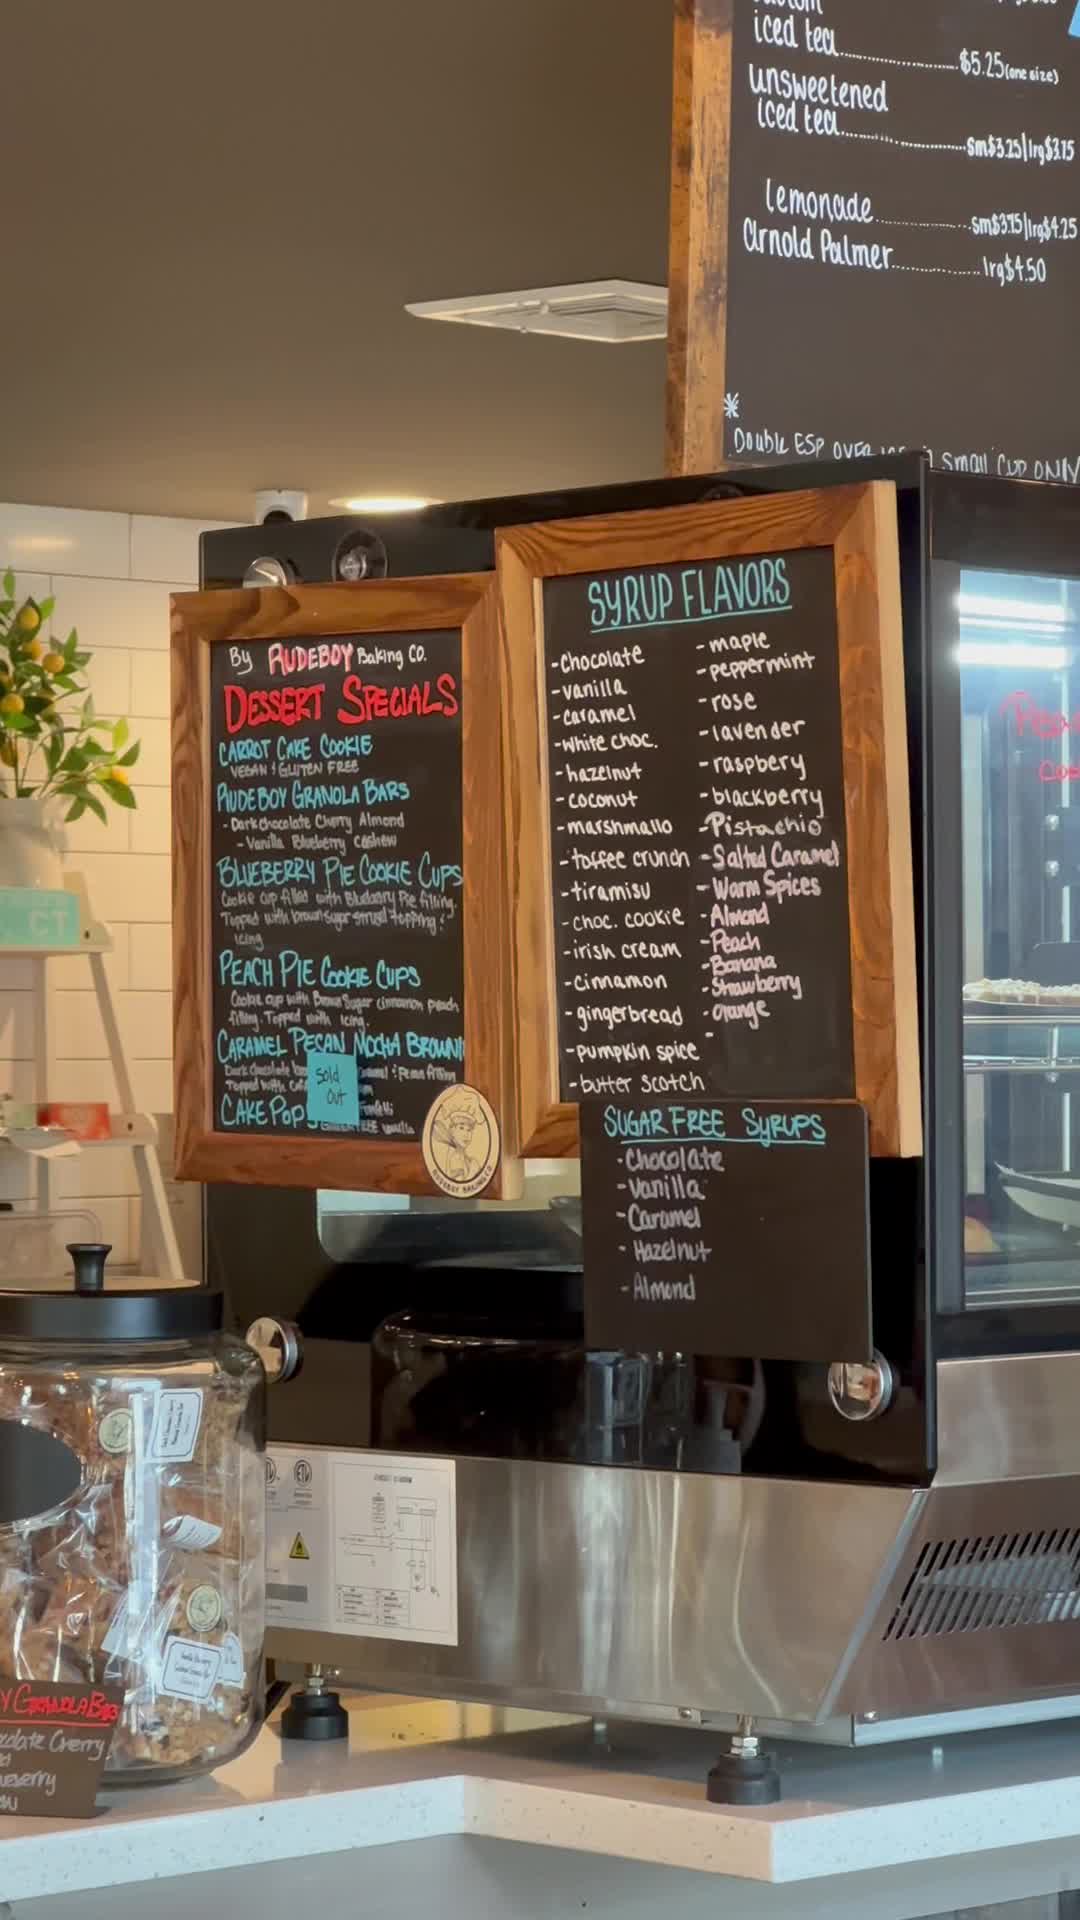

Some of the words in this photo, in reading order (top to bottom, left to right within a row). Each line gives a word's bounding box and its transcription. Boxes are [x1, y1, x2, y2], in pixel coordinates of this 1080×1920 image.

[753, 9, 799, 48] iced
[805, 17, 840, 57] tea
[804, 104, 840, 135] tea
[820, 228, 894, 270] Palmer
[794, 432, 824, 458] ESP
[588, 573, 673, 626] SYRUP
[681, 558, 790, 616] FLAVORS
[709, 631, 770, 653] maple
[229, 646, 253, 675] By
[268, 642, 353, 676] RUDEBOY
[357, 647, 404, 671] Baking
[709, 651, 816, 682] peppermint
[562, 678, 628, 700] vanilla
[711, 691, 757, 713] rose
[223, 683, 326, 733] DESSERT
[336, 673, 459, 724] SPECIALS
[563, 704, 636, 726] caramel
[712, 719, 805, 742] lavender
[218, 738, 272, 766] CARROT
[276, 735, 311, 761] CAKE
[319, 733, 374, 756] COOKIE
[230, 764, 268, 778] VEGAN
[278, 762, 324, 777] GLUTEN
[327, 759, 360, 775] FREE
[566, 762, 643, 783] hazelnut
[216, 781, 287, 813] RUDEBOY
[291, 779, 360, 809] GRANOLA
[361, 778, 410, 806] BARS
[568, 789, 638, 809] coconut
[712, 786, 825, 818] blackberry
[359, 812, 405, 829] Almond
[567, 818, 673, 836] marshmallo
[704, 811, 822, 837] Pistachio
[571, 848, 627, 870] toffee
[632, 848, 690, 868] crunch
[770, 840, 840, 868] Caramel
[216, 856, 316, 887] BLUEBERRY
[322, 857, 356, 890] PIE
[359, 853, 412, 886] COOKIE
[418, 851, 464, 891] CUPS
[571, 881, 650, 902] tiramisu
[712, 876, 761, 901] Warm
[762, 869, 822, 904] Spices
[624, 907, 685, 929] cookie
[710, 902, 770, 928] Almond
[573, 940, 616, 960] irish
[621, 940, 682, 959] cream
[710, 928, 761, 954] Peach
[219, 950, 273, 987] PEACH
[279, 950, 316, 988] PIE
[320, 955, 372, 989] COOKIE
[376, 960, 421, 991] CUPS
[710, 955, 777, 977] Banana
[574, 973, 668, 992] cinnamon
[711, 974, 802, 1000] Strawberry
[577, 1005, 683, 1032] gingerbread
[216, 1028, 288, 1064] CARAMEL
[287, 1026, 346, 1055] PECAN
[353, 1030, 401, 1059] MOCHA
[405, 1031, 465, 1062] BROWNI
[576, 1042, 650, 1063] pumpkin
[657, 1041, 700, 1063] spice
[580, 1074, 632, 1095] butter
[641, 1071, 705, 1094] scotch
[221, 1093, 268, 1126] CAKE
[603, 1104, 669, 1137] SUGAR
[668, 1106, 726, 1137] FREE
[625, 1146, 725, 1173] Chocolate
[628, 1173, 706, 1200] Vanilla
[627, 1203, 701, 1232] Caramel
[633, 1239, 712, 1262] Hazelnut
[633, 1272, 695, 1301] Almond
